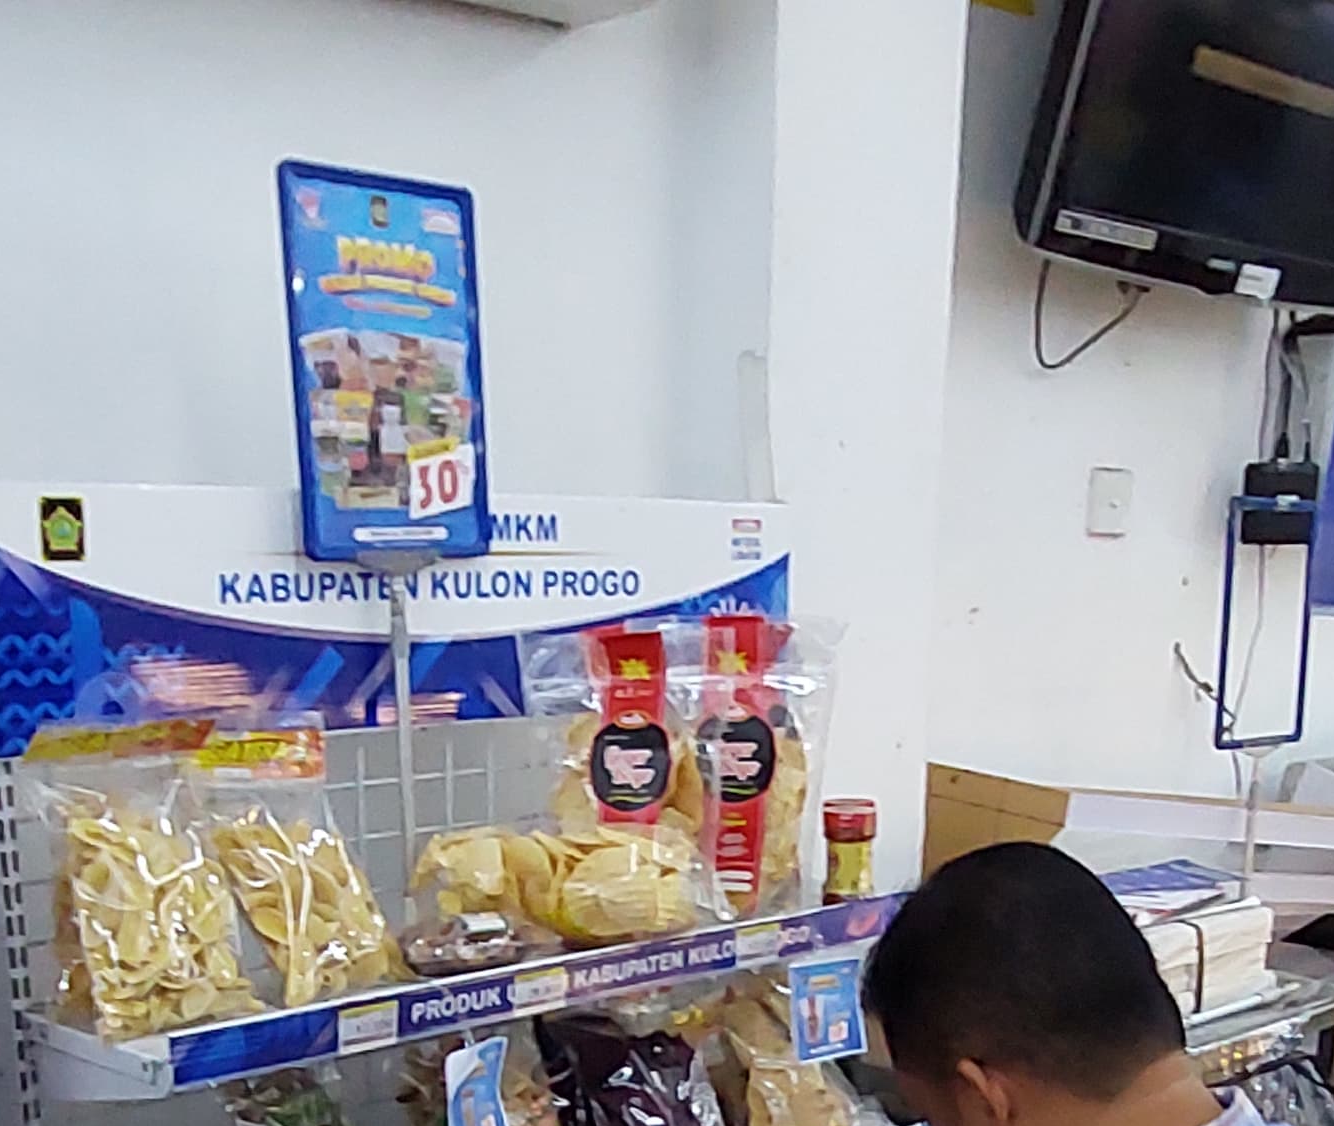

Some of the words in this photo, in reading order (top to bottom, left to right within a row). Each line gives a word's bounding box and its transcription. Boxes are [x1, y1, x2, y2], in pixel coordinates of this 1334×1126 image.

[489, 513, 559, 542] MKM
[219, 569, 419, 603] KABUPATEN
[432, 568, 532, 599] KULON
[543, 569, 640, 598] PROGO
[410, 987, 502, 1022] PRODUK
[573, 949, 685, 987] KABUPATEN
[688, 939, 736, 965] KULO
